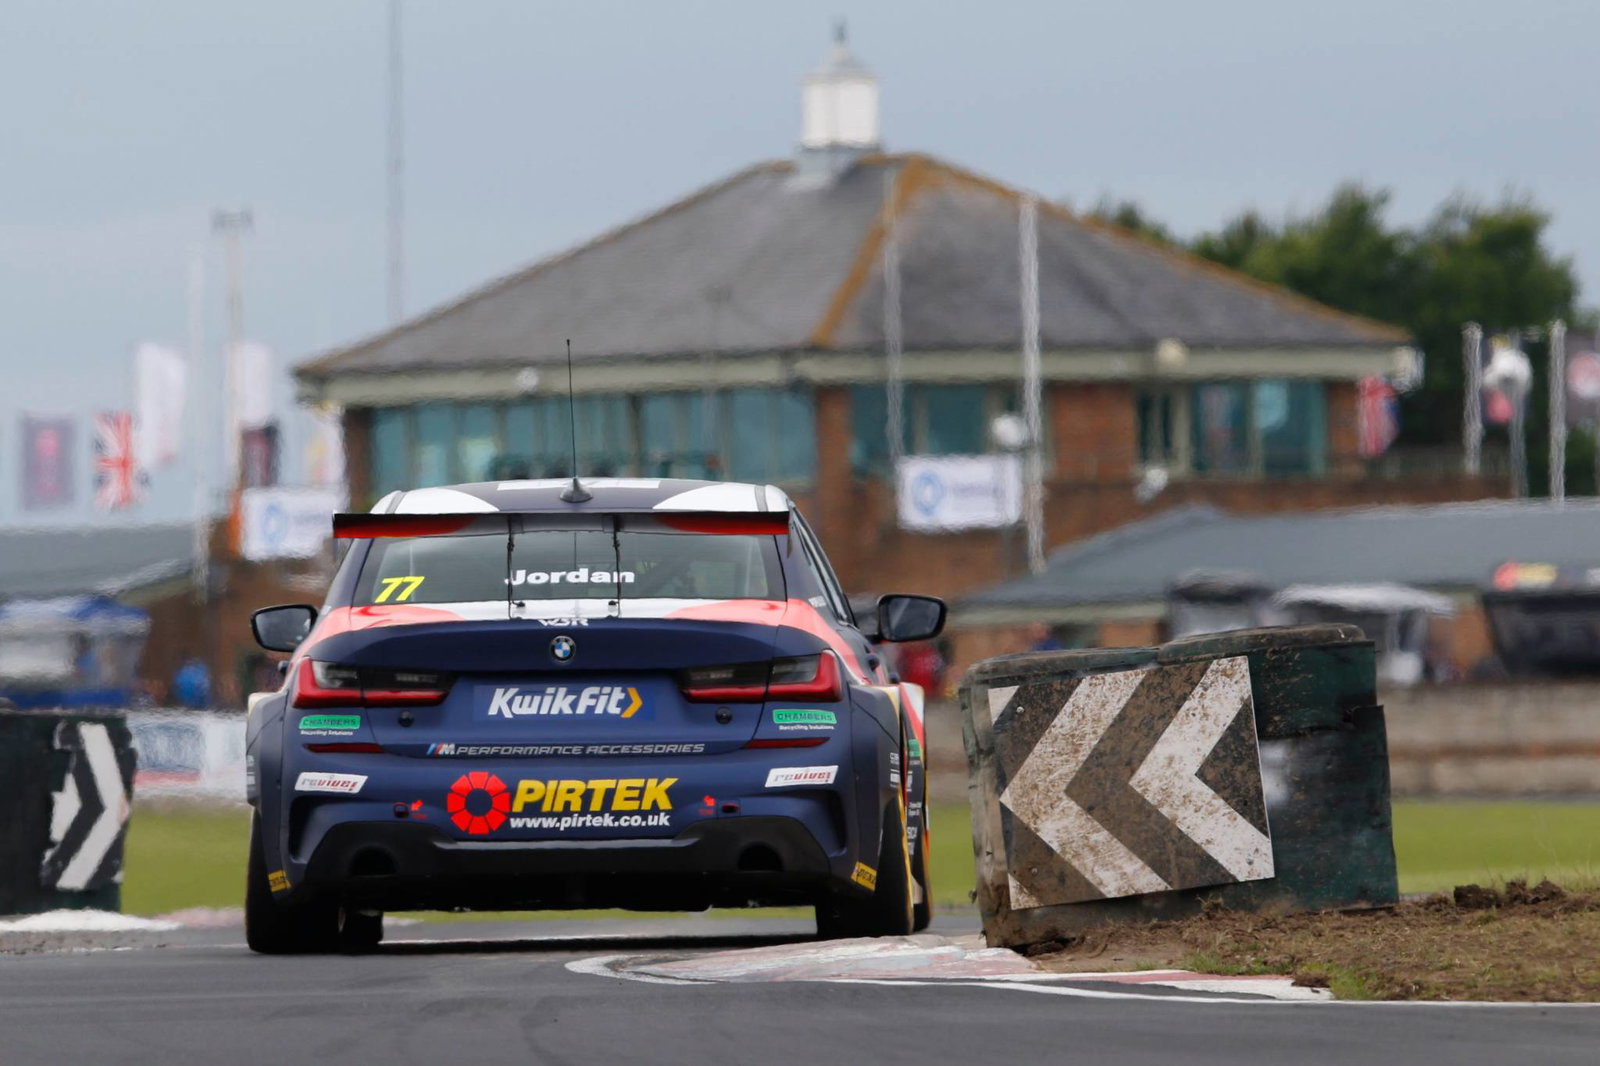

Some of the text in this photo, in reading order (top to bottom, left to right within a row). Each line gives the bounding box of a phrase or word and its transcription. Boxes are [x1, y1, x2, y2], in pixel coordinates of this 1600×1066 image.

[504, 567, 635, 586] Jordan
[374, 575, 425, 603] 77
[585, 743, 706, 754] ACCESSORIES
[511, 777, 679, 813] PIRTEK
[509, 811, 671, 831] www.pirtek.co.uk
